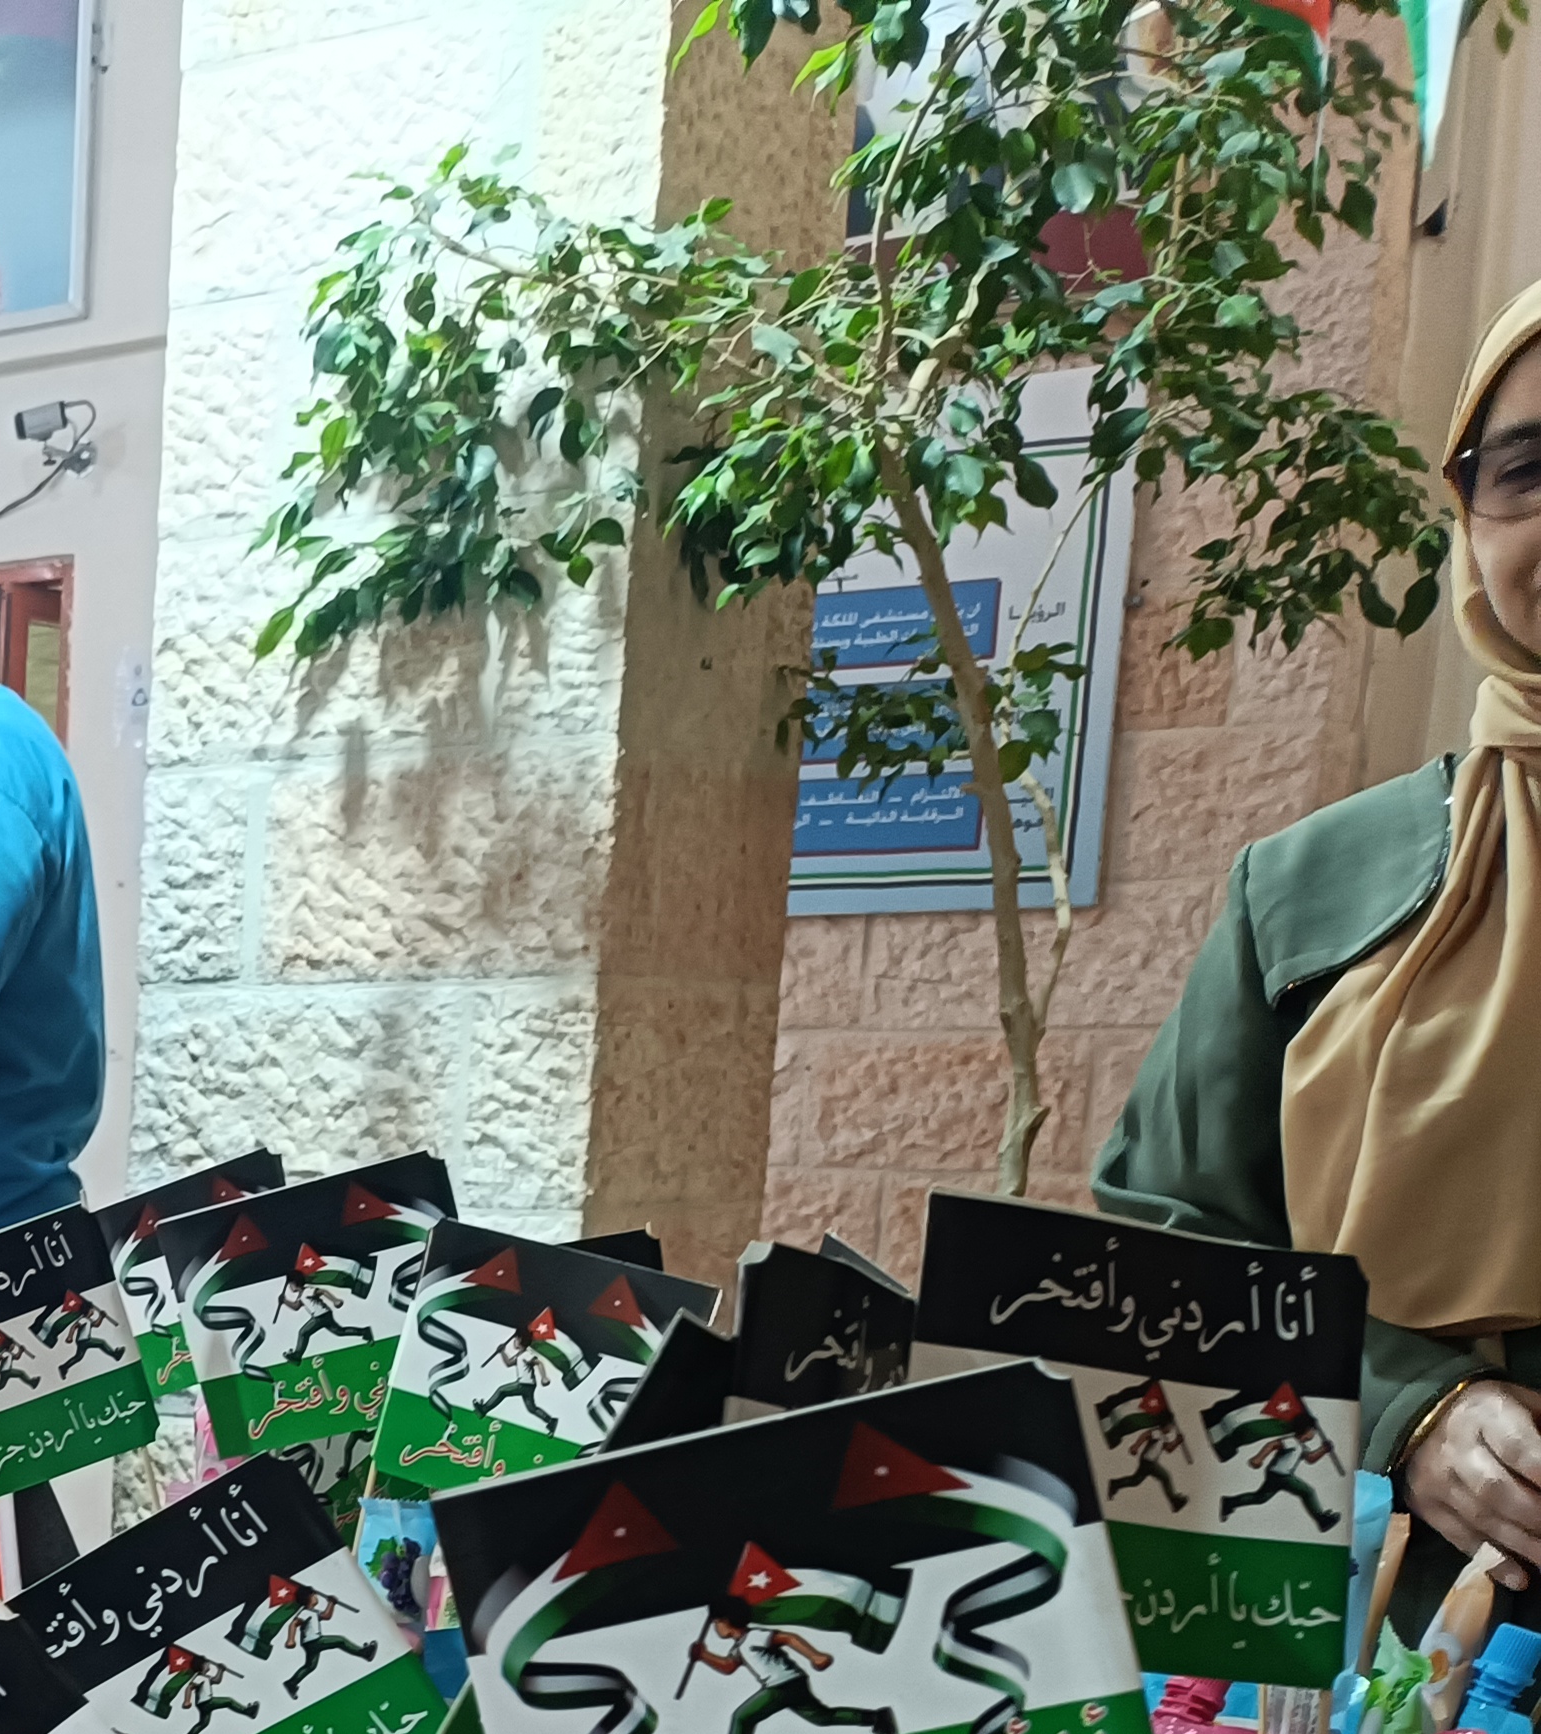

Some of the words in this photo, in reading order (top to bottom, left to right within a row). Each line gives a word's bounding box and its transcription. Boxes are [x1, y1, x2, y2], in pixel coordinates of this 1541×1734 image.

[45, 1220, 74, 1268] أنا
[989, 1237, 1137, 1334] وأفتخر
[1137, 1260, 1266, 1362] أردني
[1274, 1265, 1319, 1341] أنا
[31, 1397, 80, 1460] أردن
[221, 1483, 269, 1550] أنا
[127, 1505, 228, 1639] أردني
[1133, 1552, 1223, 1634] أردن
[47, 1582, 121, 1660] وأفت
